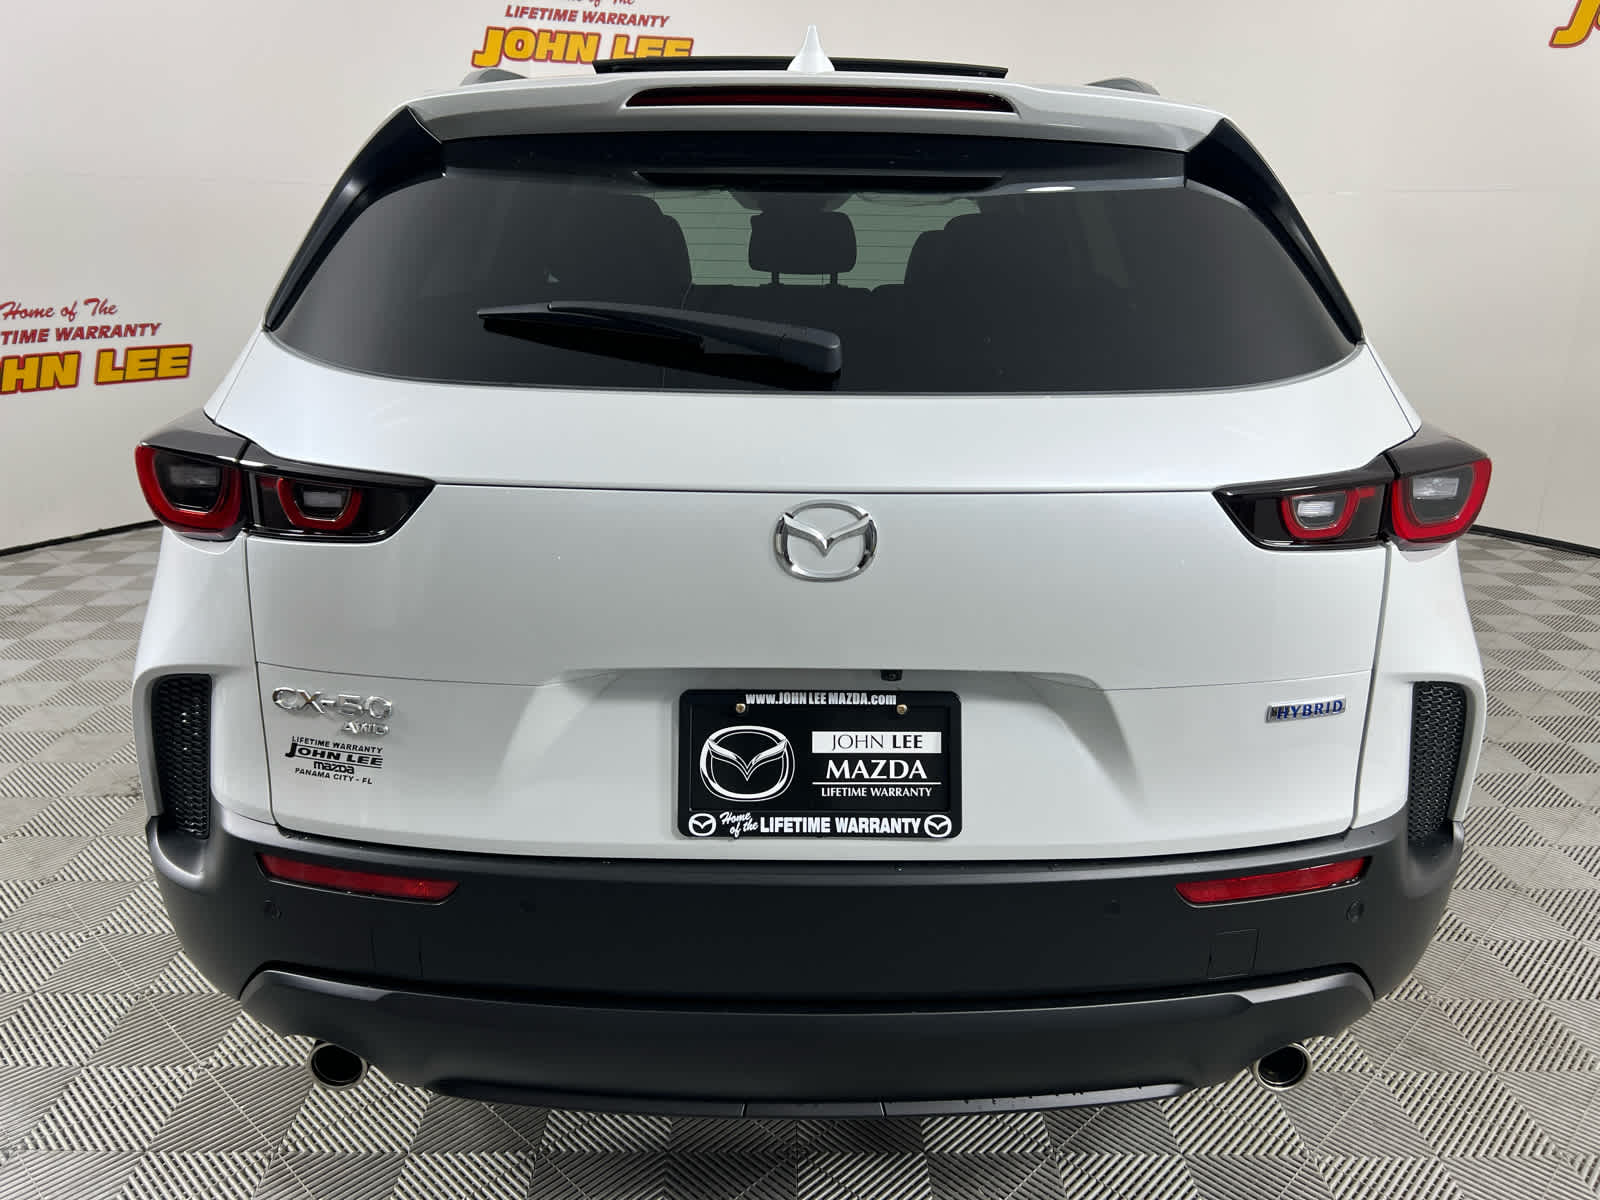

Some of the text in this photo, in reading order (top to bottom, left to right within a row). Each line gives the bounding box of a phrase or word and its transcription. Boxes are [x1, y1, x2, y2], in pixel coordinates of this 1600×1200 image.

[505, 5, 670, 28] LIFETIME WARRANTY
[472, 26, 602, 69] JOHN
[0, 298, 118, 322] Home of The
[0, 323, 162, 345] TIME WARRANTY
[0, 344, 192, 395] HN LEE
[272, 686, 392, 719] CX-50
[1276, 699, 1344, 720] HYBRID
[292, 736, 383, 754] LIFETIME WARRANTY
[831, 734, 923, 751] JOHN LEE
[285, 742, 384, 766] JOHN LEE
[295, 767, 330, 779] PANAMA
[333, 773, 354, 782] CITY
[362, 777, 373, 785] FL
[826, 759, 927, 779] MAZDA
[821, 787, 932, 798] LIFETIME WARRANTY
[719, 811, 752, 825] Home
[760, 816, 922, 834] LIFETIME WARRANTY
[729, 820, 759, 838] of the
